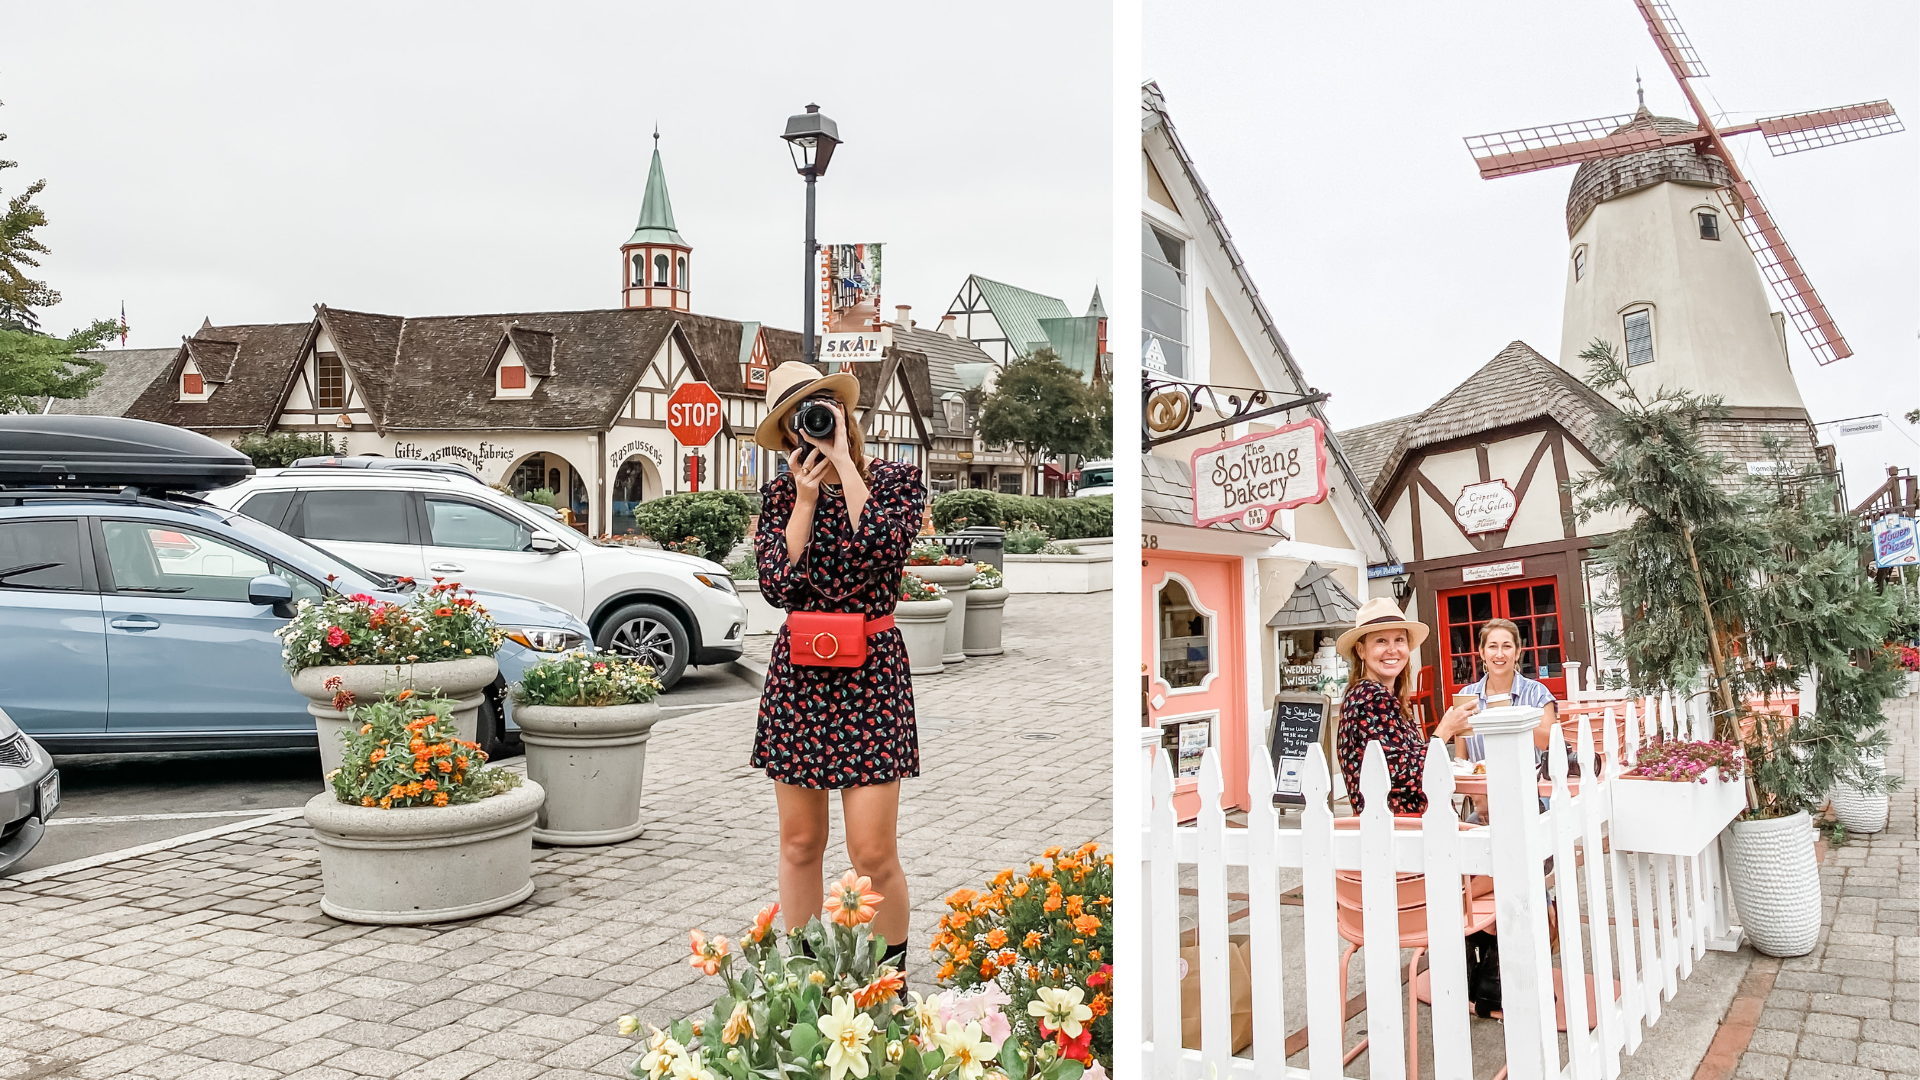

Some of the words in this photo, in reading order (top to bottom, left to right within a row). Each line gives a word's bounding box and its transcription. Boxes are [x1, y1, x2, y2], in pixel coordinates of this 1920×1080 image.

[820, 244, 830, 333] SHOPPING
[671, 403, 718, 427] STOP
[395, 441, 422, 459] Gifts
[479, 441, 514, 462] Fabrics
[1245, 443, 1265, 456] The
[1212, 447, 1301, 486] Solvang
[1223, 476, 1289, 508] Bakery
[1249, 509, 1263, 518] EST
[1485, 498, 1513, 514] Gelato
[1880, 527, 1910, 544] Tower
[1881, 537, 1914, 556] Pizza
[1284, 665, 1321, 675] WEDDING
